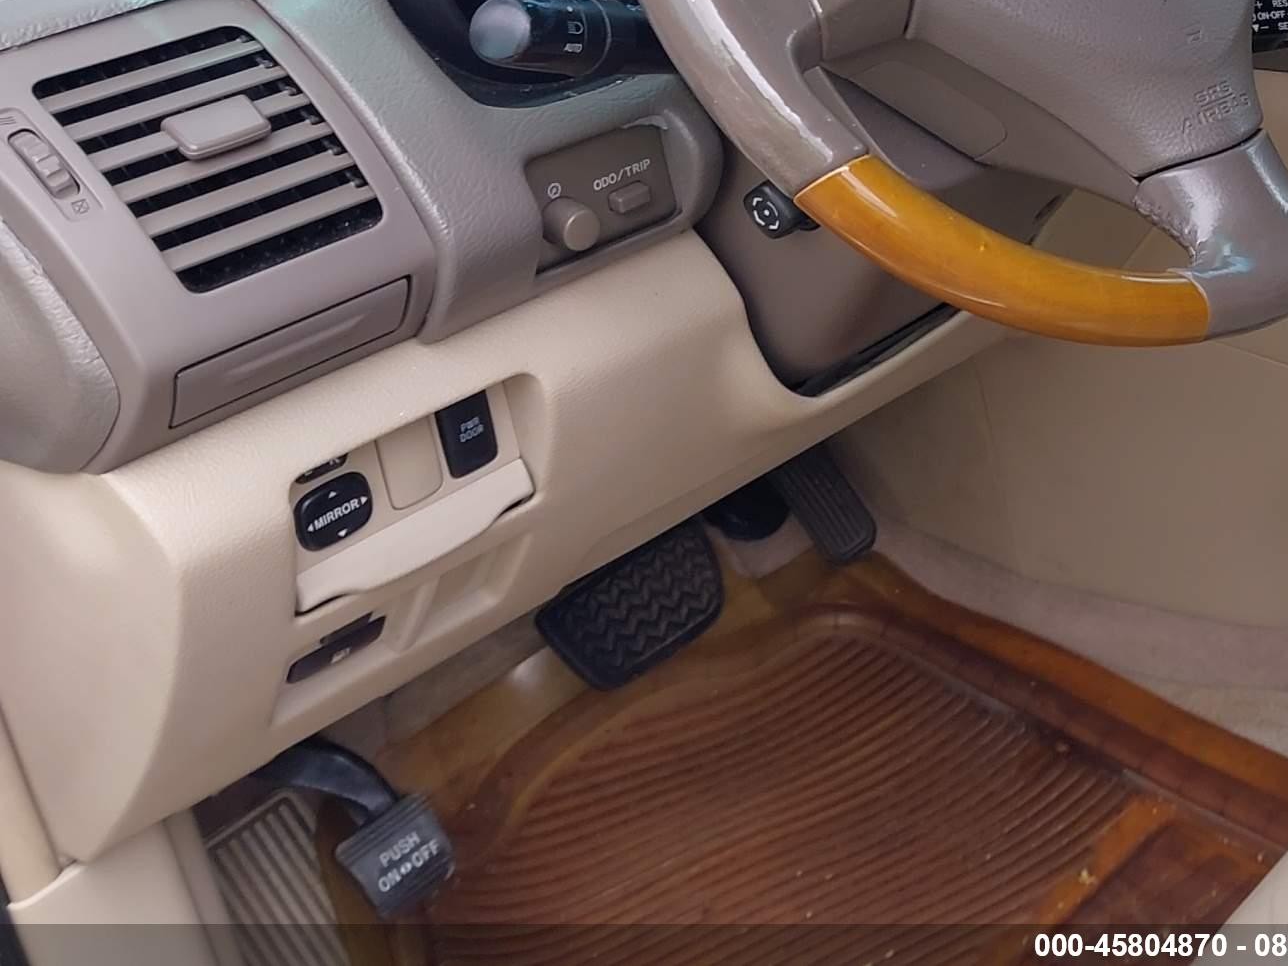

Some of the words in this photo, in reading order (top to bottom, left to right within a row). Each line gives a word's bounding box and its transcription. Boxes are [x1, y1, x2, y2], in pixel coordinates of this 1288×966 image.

[1257, 10, 1286, 21] ON-OFF
[593, 158, 650, 191] ODO/TRIP
[459, 416, 480, 433] PWR
[459, 424, 485, 443] DOOR
[313, 498, 360, 531] MIRROR
[379, 831, 420, 868] PUSH
